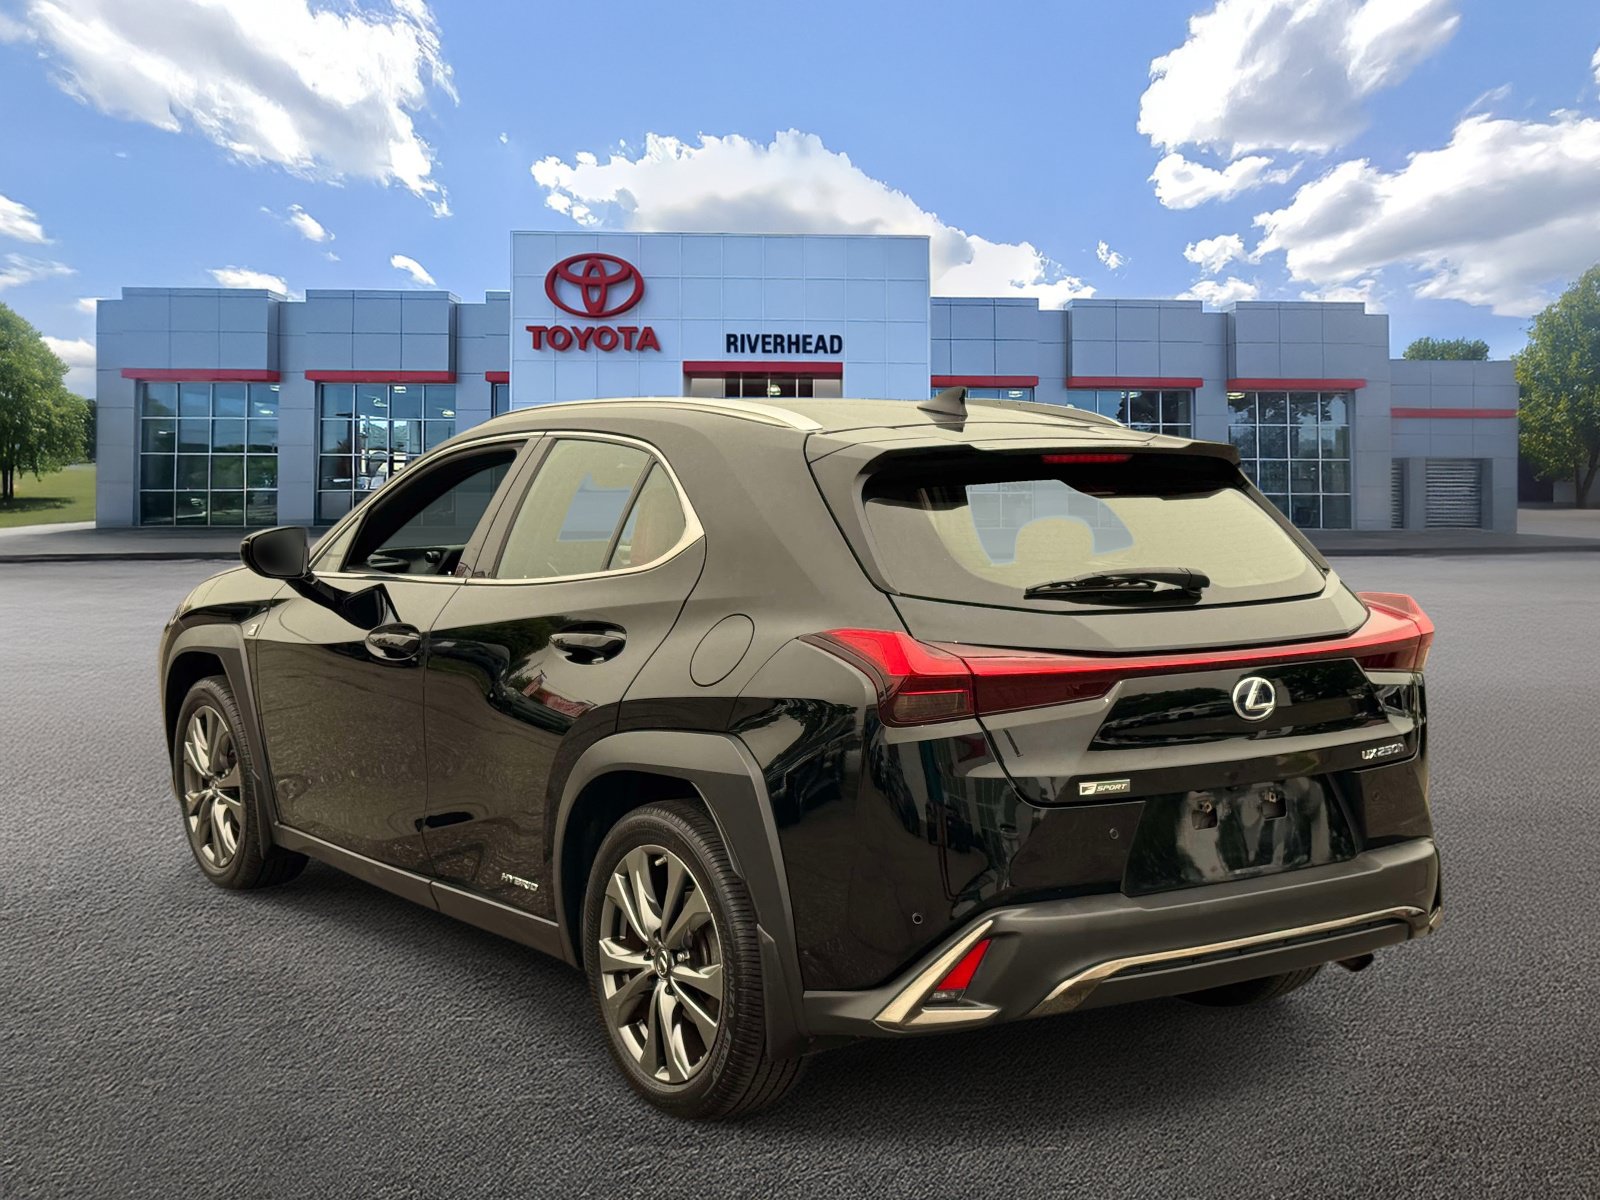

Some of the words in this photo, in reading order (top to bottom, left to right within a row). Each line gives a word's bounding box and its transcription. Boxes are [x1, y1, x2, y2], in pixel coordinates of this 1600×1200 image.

[526, 325, 662, 353] TOYOTA
[725, 333, 843, 354] RIVERHEAD
[1096, 783, 1128, 792] SPORT
